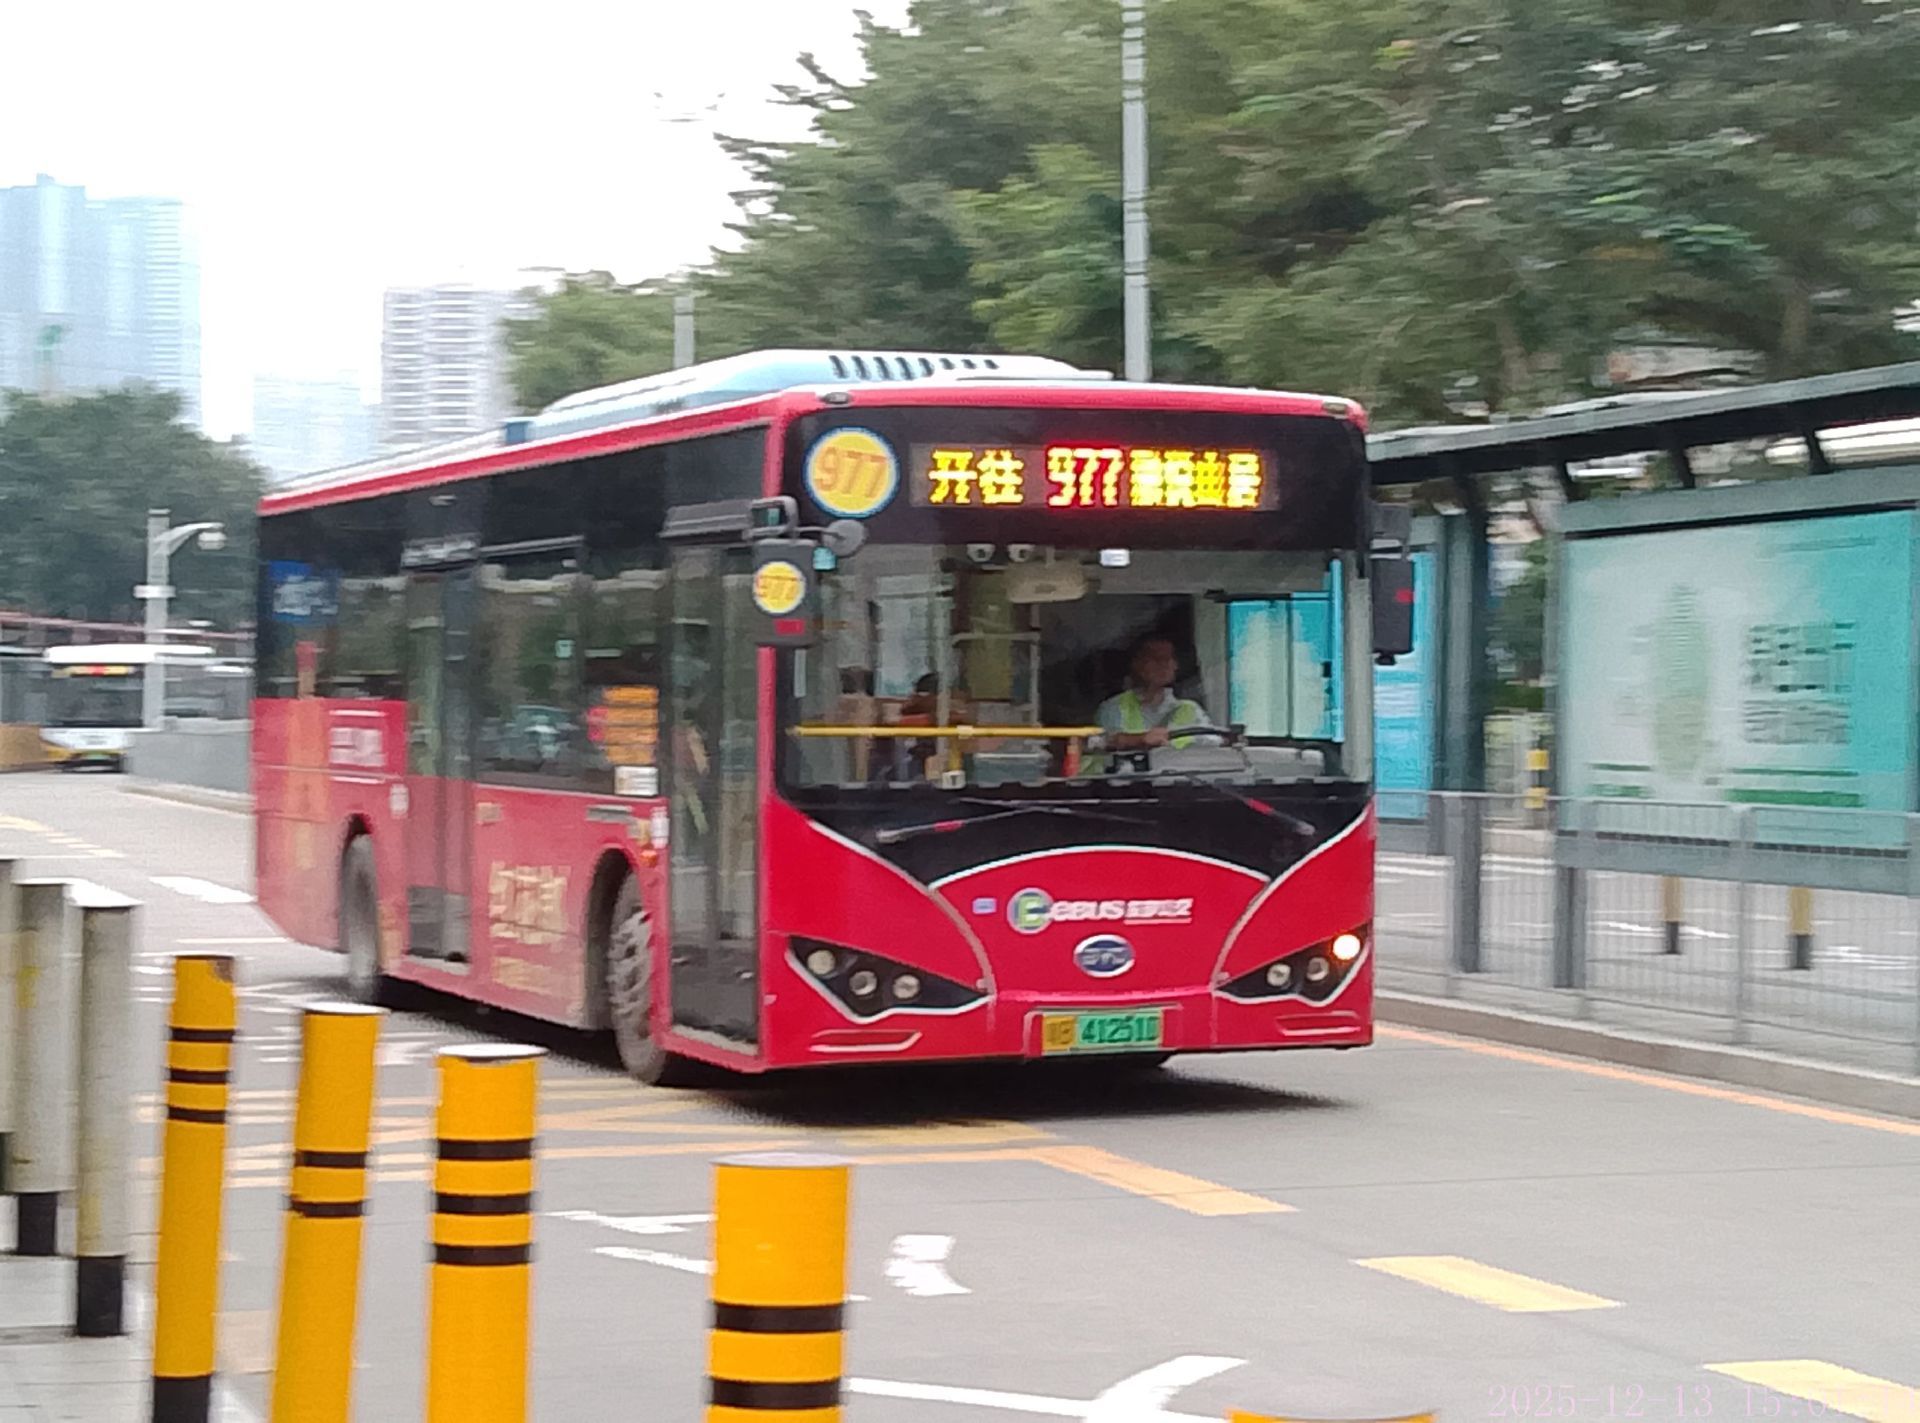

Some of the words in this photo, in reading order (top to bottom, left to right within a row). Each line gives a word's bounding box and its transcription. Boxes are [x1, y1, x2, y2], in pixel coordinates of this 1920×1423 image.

[813, 447, 888, 499] 977
[928, 449, 1024, 505] 开往
[1046, 447, 1125, 507] 977
